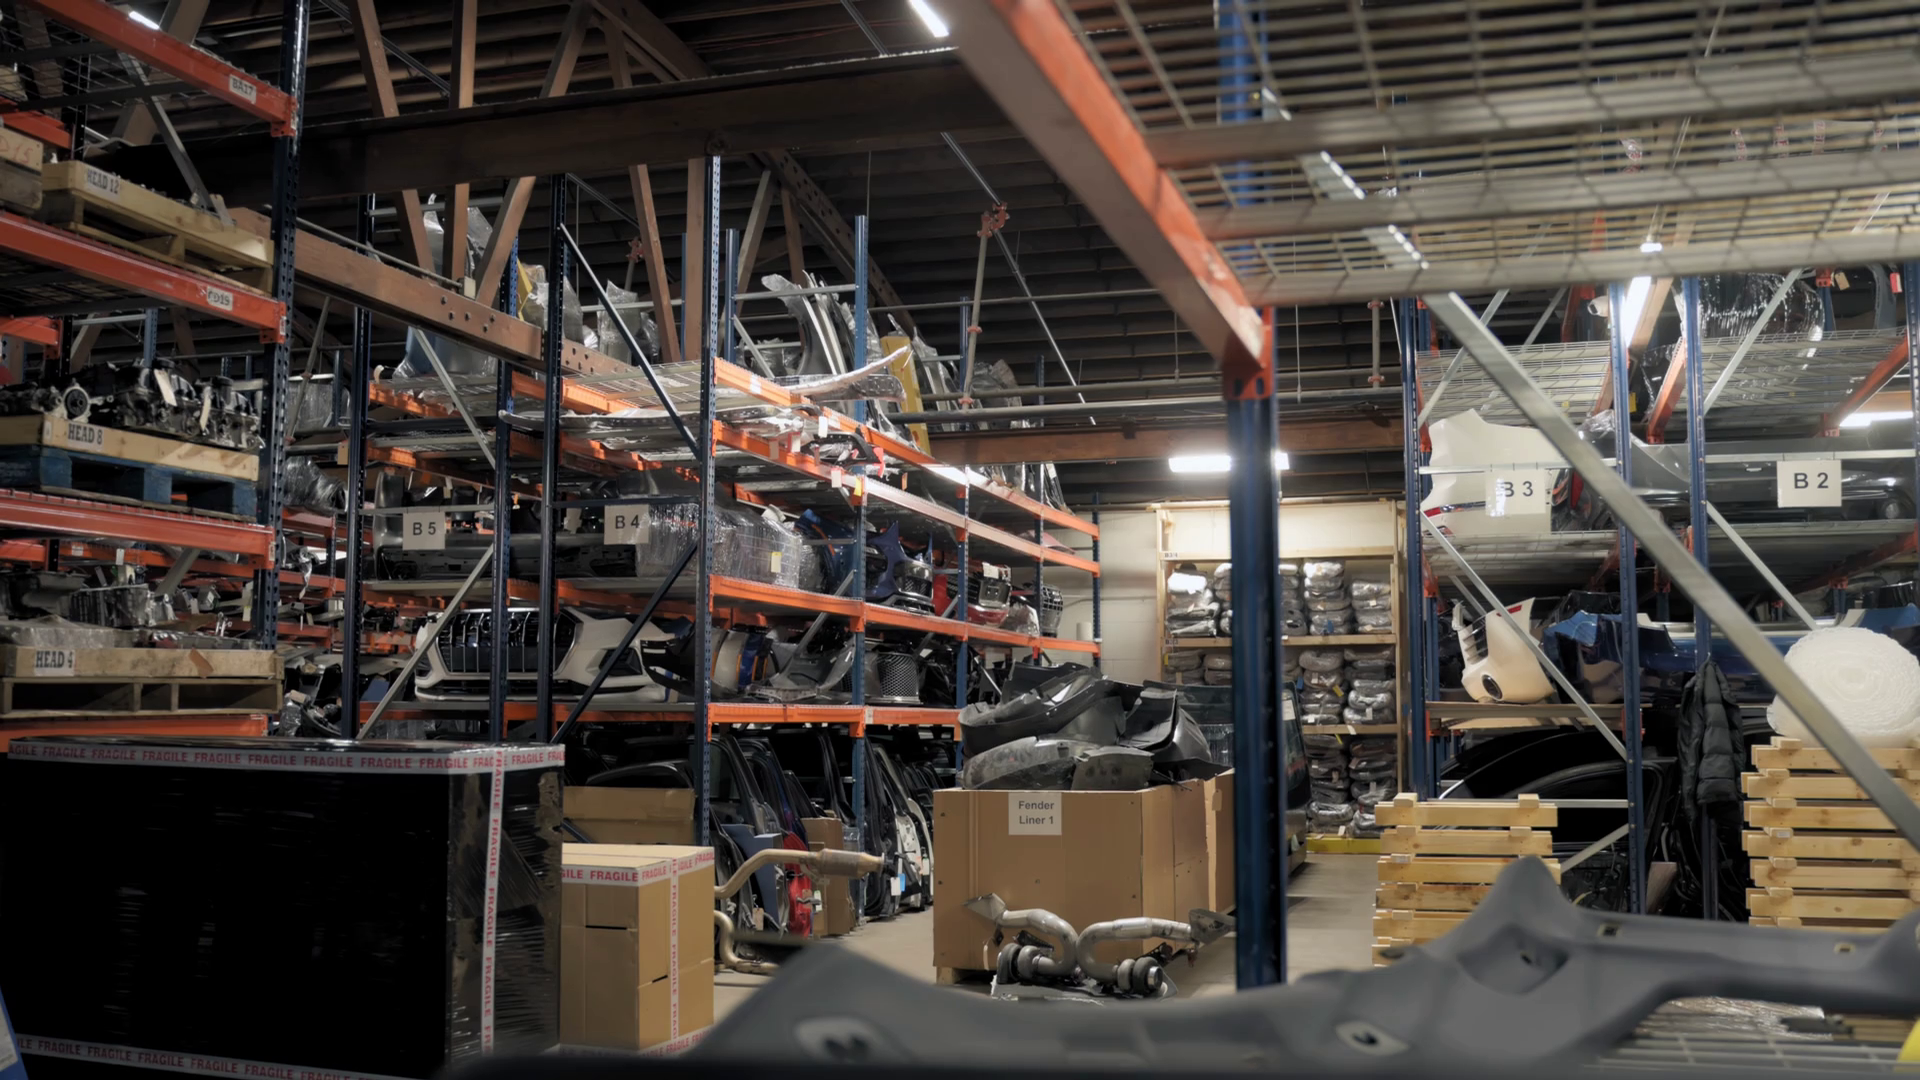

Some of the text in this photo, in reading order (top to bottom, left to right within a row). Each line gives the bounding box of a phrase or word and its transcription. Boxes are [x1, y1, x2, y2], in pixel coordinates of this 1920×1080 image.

[87, 169, 119, 194] HEAD 12
[68, 423, 103, 445] HEAD 8
[1500, 481, 1533, 498] B 3
[1794, 472, 1828, 489] B 2
[413, 522, 436, 536] B 5
[615, 514, 640, 529] B 4
[36, 650, 73, 669] HEAD 4
[9, 744, 37, 756] AGILE
[42, 746, 86, 759] FRAGILE
[92, 748, 136, 760] FRAGILE
[142, 750, 188, 762] FRAGILE
[194, 752, 241, 764] FRAGILE
[248, 754, 297, 766] FRAGILE
[303, 756, 353, 768] FRAGILE
[361, 757, 412, 769] FRAGILE
[419, 758, 469, 769] FRAGILE
[511, 752, 544, 765] FRAGILE
[493, 750, 502, 808] FRAGILE
[1018, 800, 1055, 810] Fender
[1019, 815, 1054, 825] Liner 1
[489, 818, 498, 878] FRAGILE
[561, 868, 583, 880] GILE
[590, 870, 638, 882] FRAGILE
[642, 865, 667, 880] FRAGILE
[486, 888, 495, 947] FRAGILE
[484, 957, 492, 1017] FRAGILE
[38, 1040, 81, 1055] FRAGILE
[87, 1046, 132, 1062] FRAGILE
[138, 1053, 184, 1067] FRAGILE
[190, 1058, 238, 1073] FRAGILE
[245, 1064, 293, 1080] FRAGILE
